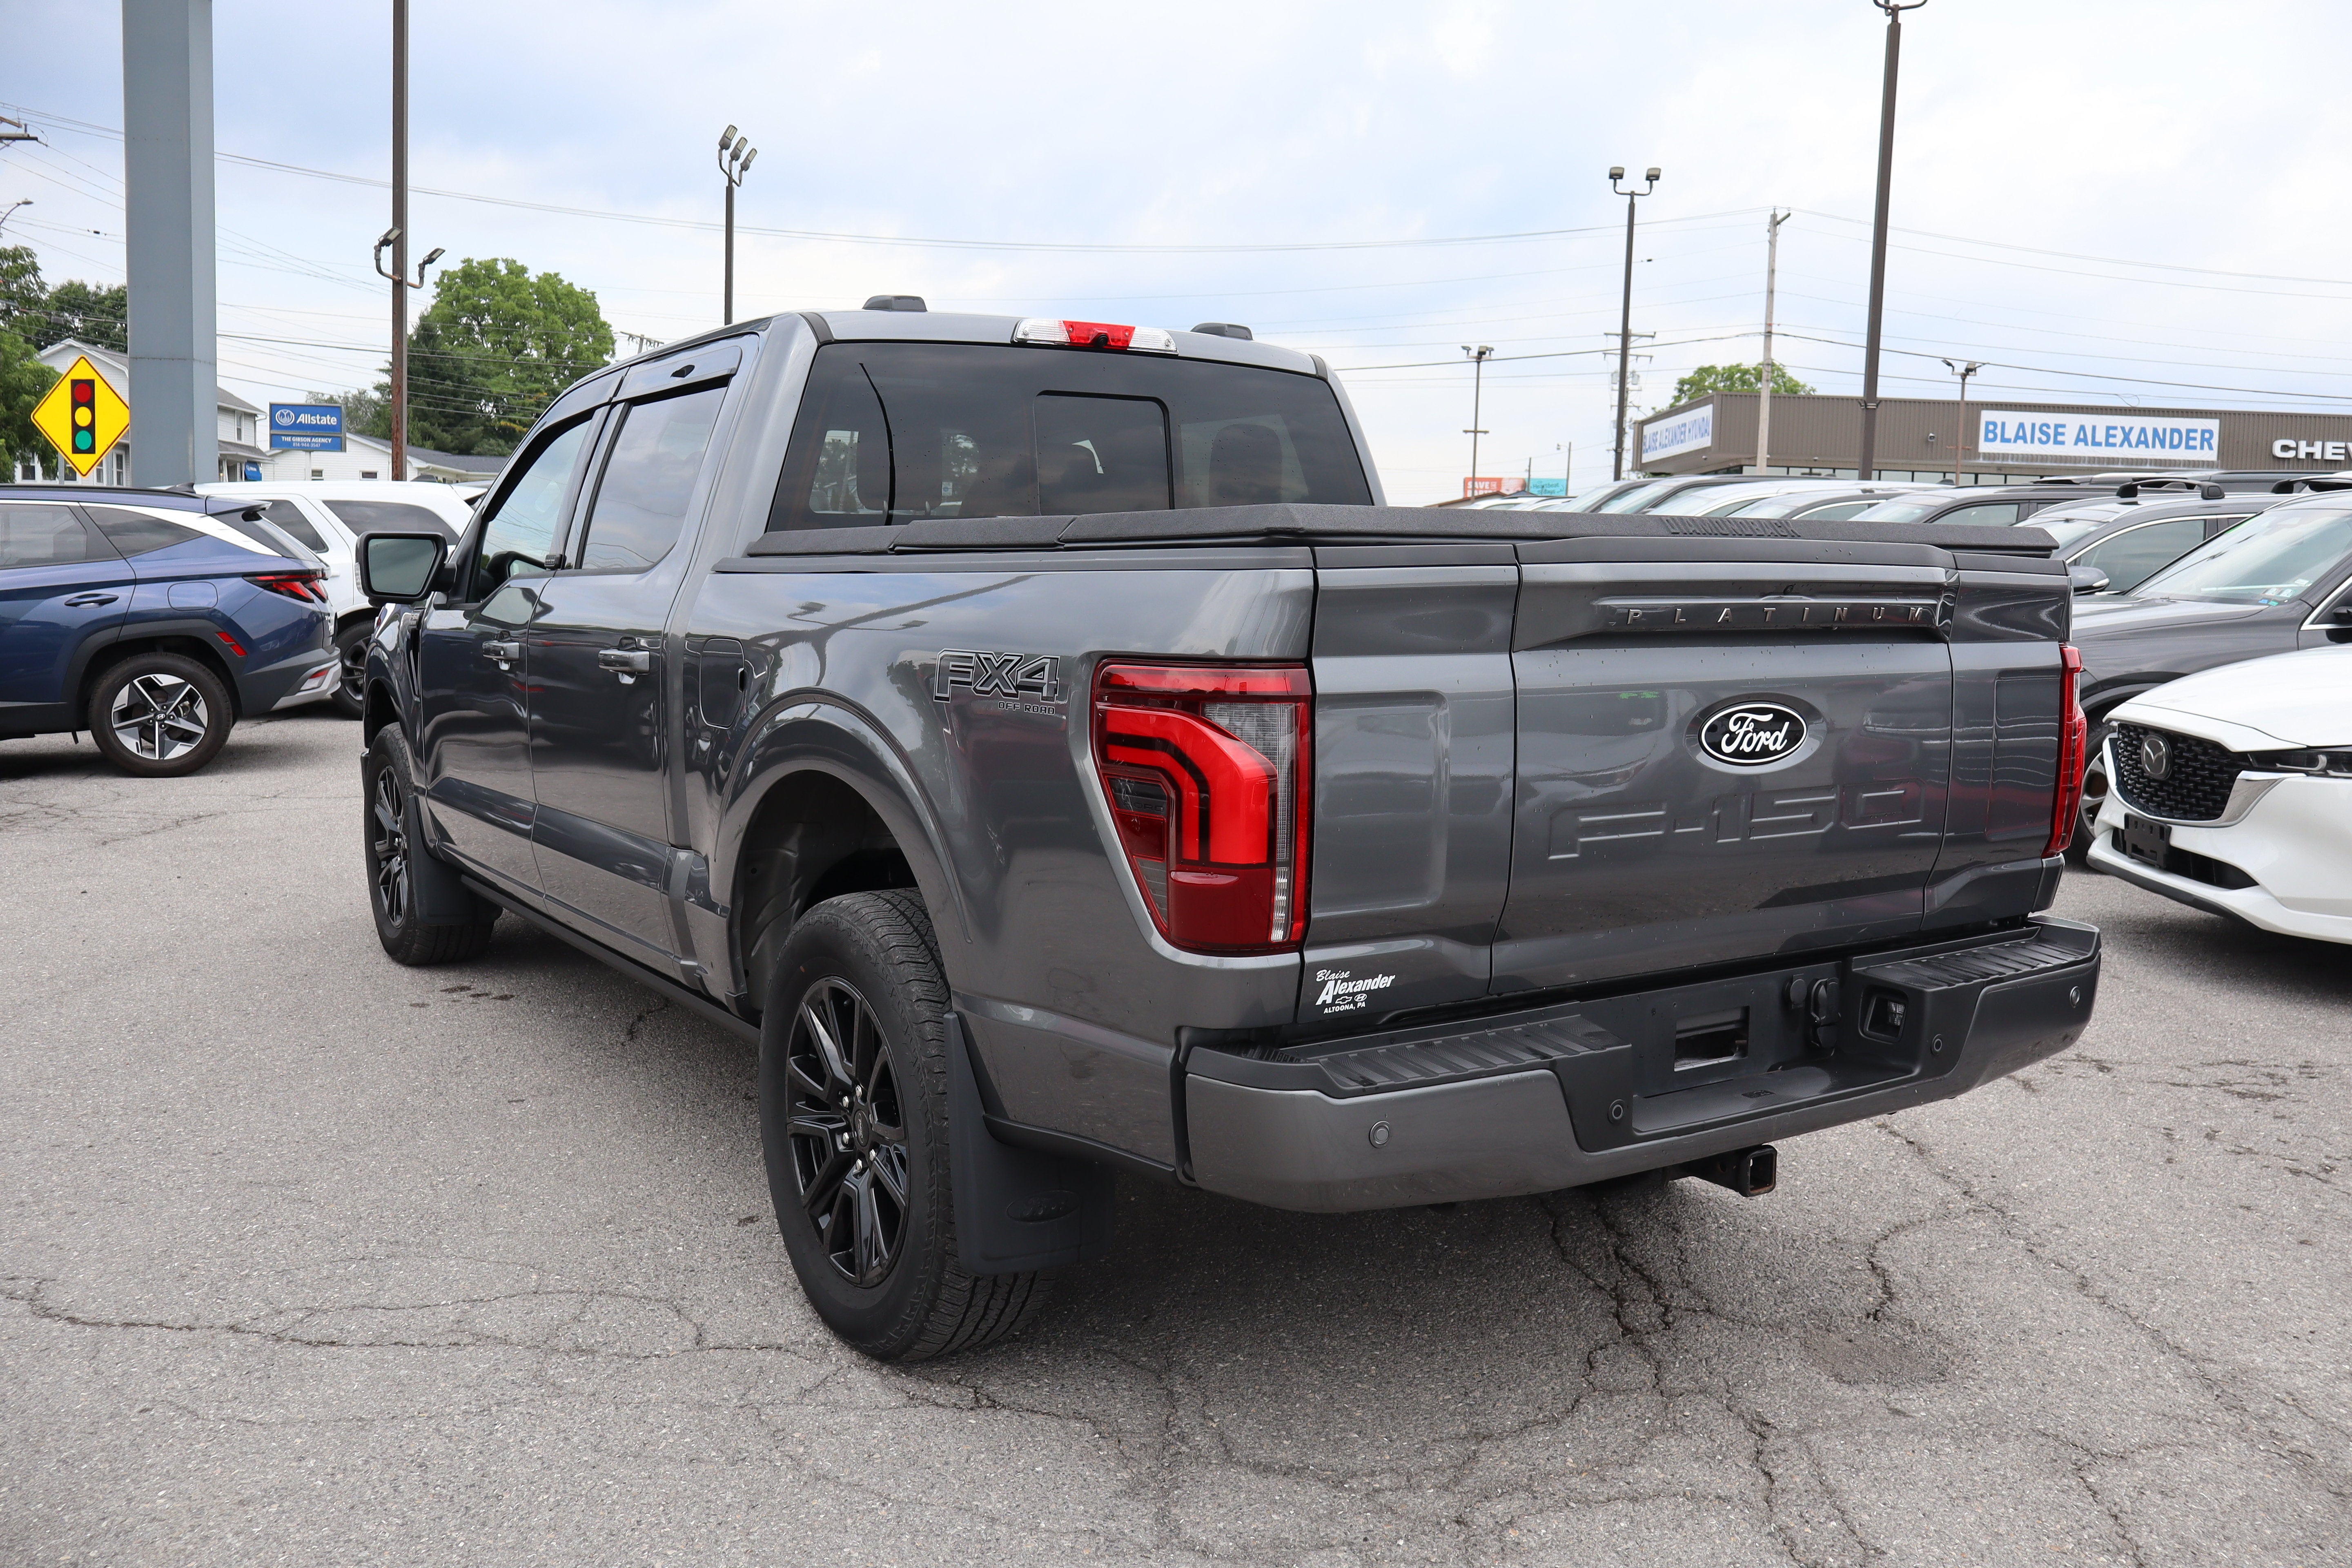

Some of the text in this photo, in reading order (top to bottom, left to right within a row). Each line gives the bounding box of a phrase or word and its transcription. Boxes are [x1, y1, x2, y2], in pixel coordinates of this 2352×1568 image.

[296, 414, 337, 425] Allstate
[1643, 430, 1658, 454] BLAISE
[1659, 422, 1686, 450] ALEXANDER
[1984, 421, 2214, 450] BLAISE ALEXANDER
[2272, 439, 2352, 461] CHE
[1661, 517, 1801, 537] DIAMONDBACK
[1627, 607, 1923, 625] PLATINUM
[933, 648, 1060, 703] FX4
[998, 701, 1055, 715] OFF ROAD
[1721, 713, 1789, 753] Ford
[1548, 777, 1926, 859] F-150
[1316, 969, 1350, 981] Blaise
[1315, 974, 1395, 1005] Alexander
[1323, 1004, 1355, 1013] ALTOONA,
